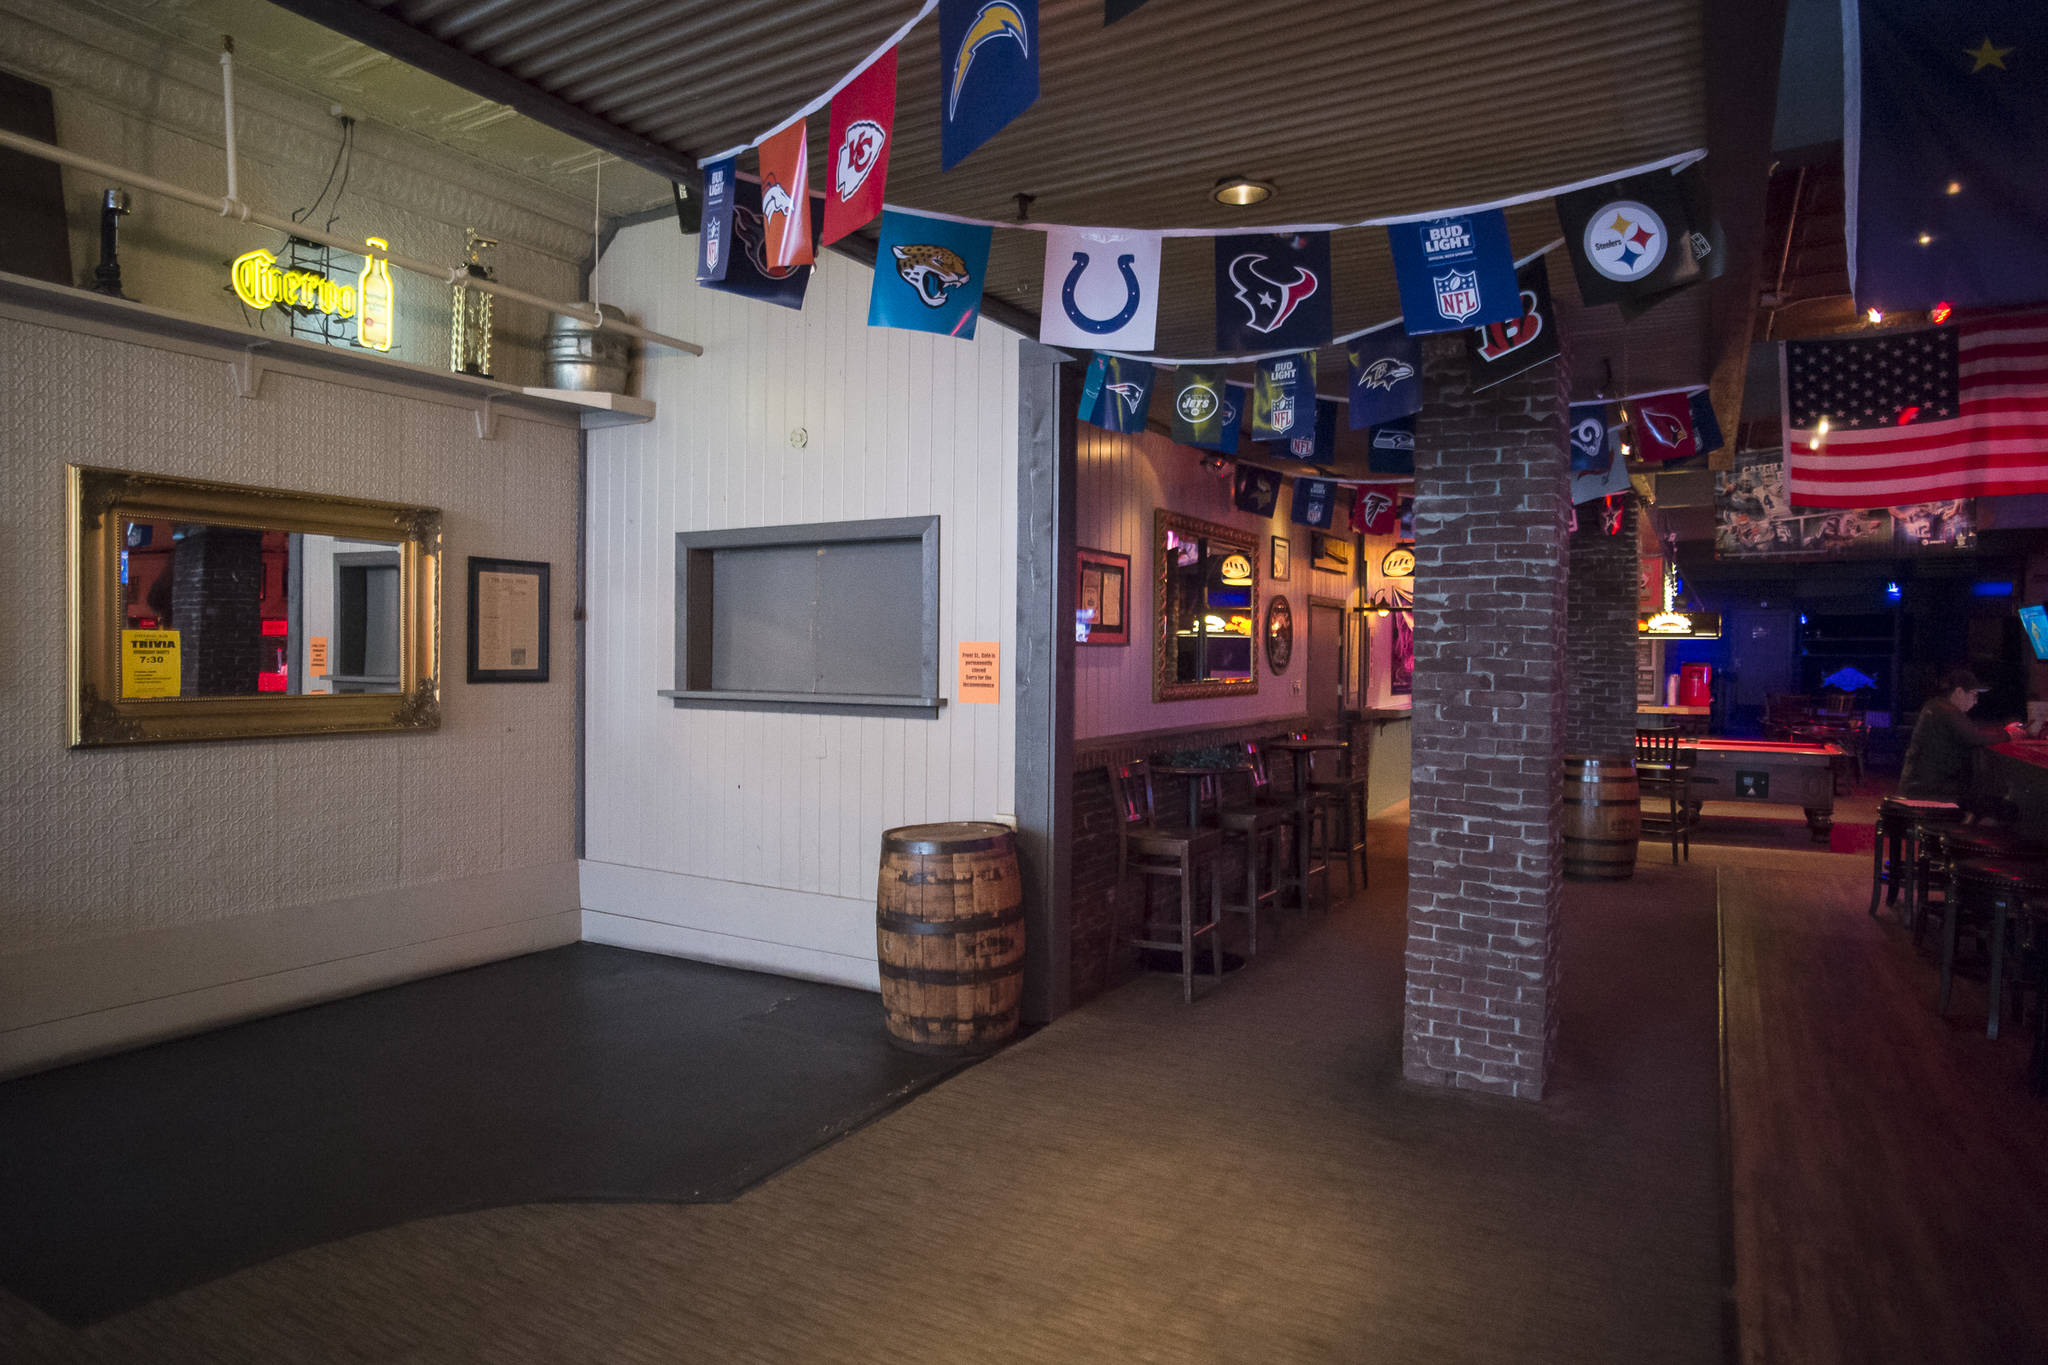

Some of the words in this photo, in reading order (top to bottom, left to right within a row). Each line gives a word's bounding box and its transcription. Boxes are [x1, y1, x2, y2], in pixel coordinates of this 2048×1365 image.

[711, 170, 724, 184] BUD
[709, 182, 724, 197] LIGHT
[1430, 225, 1462, 241] BUD
[1425, 234, 1470, 253] LIGHT
[1595, 239, 1622, 251] Steelers
[232, 248, 356, 318] Cuervo
[1442, 291, 1476, 315] NFL
[1275, 361, 1293, 372] BUD
[1271, 368, 1297, 381] LIGHT
[1274, 411, 1291, 428] NFL
[1293, 439, 1311, 454] NFL
[131, 640, 176, 649] TRIVIA
[140, 656, 164, 664] 7:30
